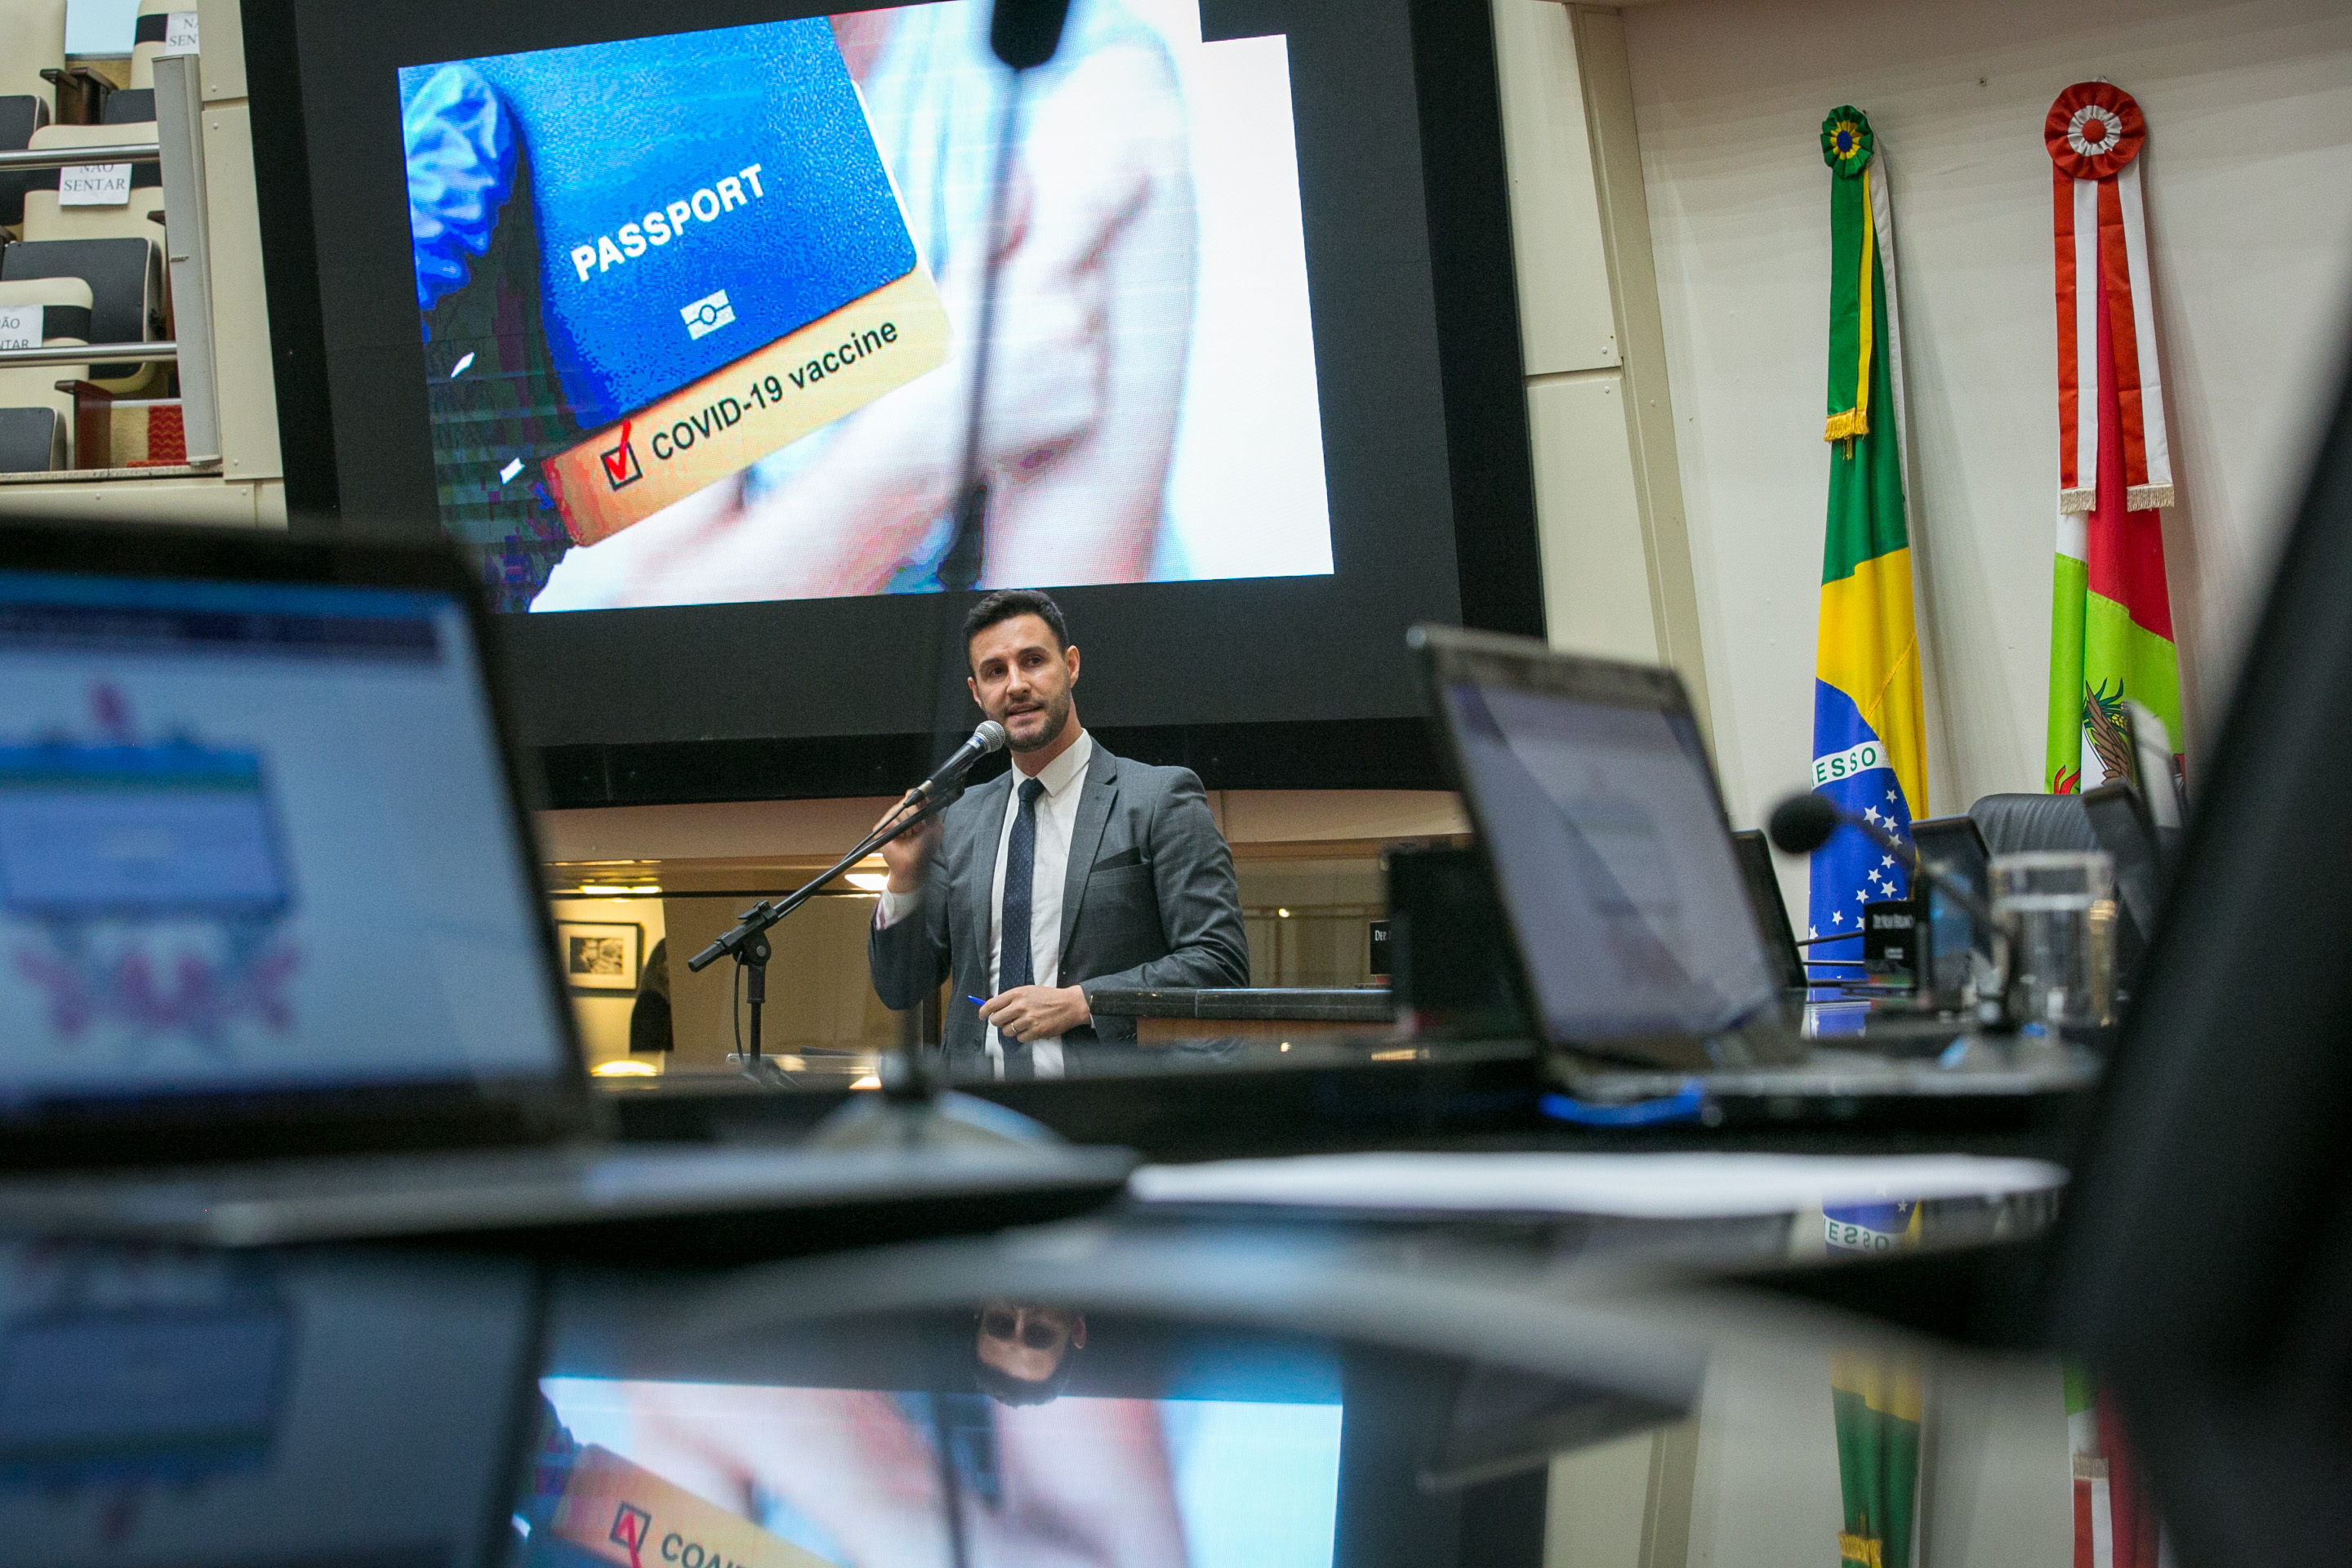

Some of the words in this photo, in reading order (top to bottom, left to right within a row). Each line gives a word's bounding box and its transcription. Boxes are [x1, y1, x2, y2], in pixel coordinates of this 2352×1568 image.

[169, 34, 198, 47] SEN
[64, 178, 126, 192] SENTAR
[571, 163, 764, 282] PASSPORT
[0, 316, 20, 329] ÃO
[651, 376, 784, 460] COVID-19
[788, 322, 898, 389] vaccine
[1811, 746, 1877, 787] ESSO
